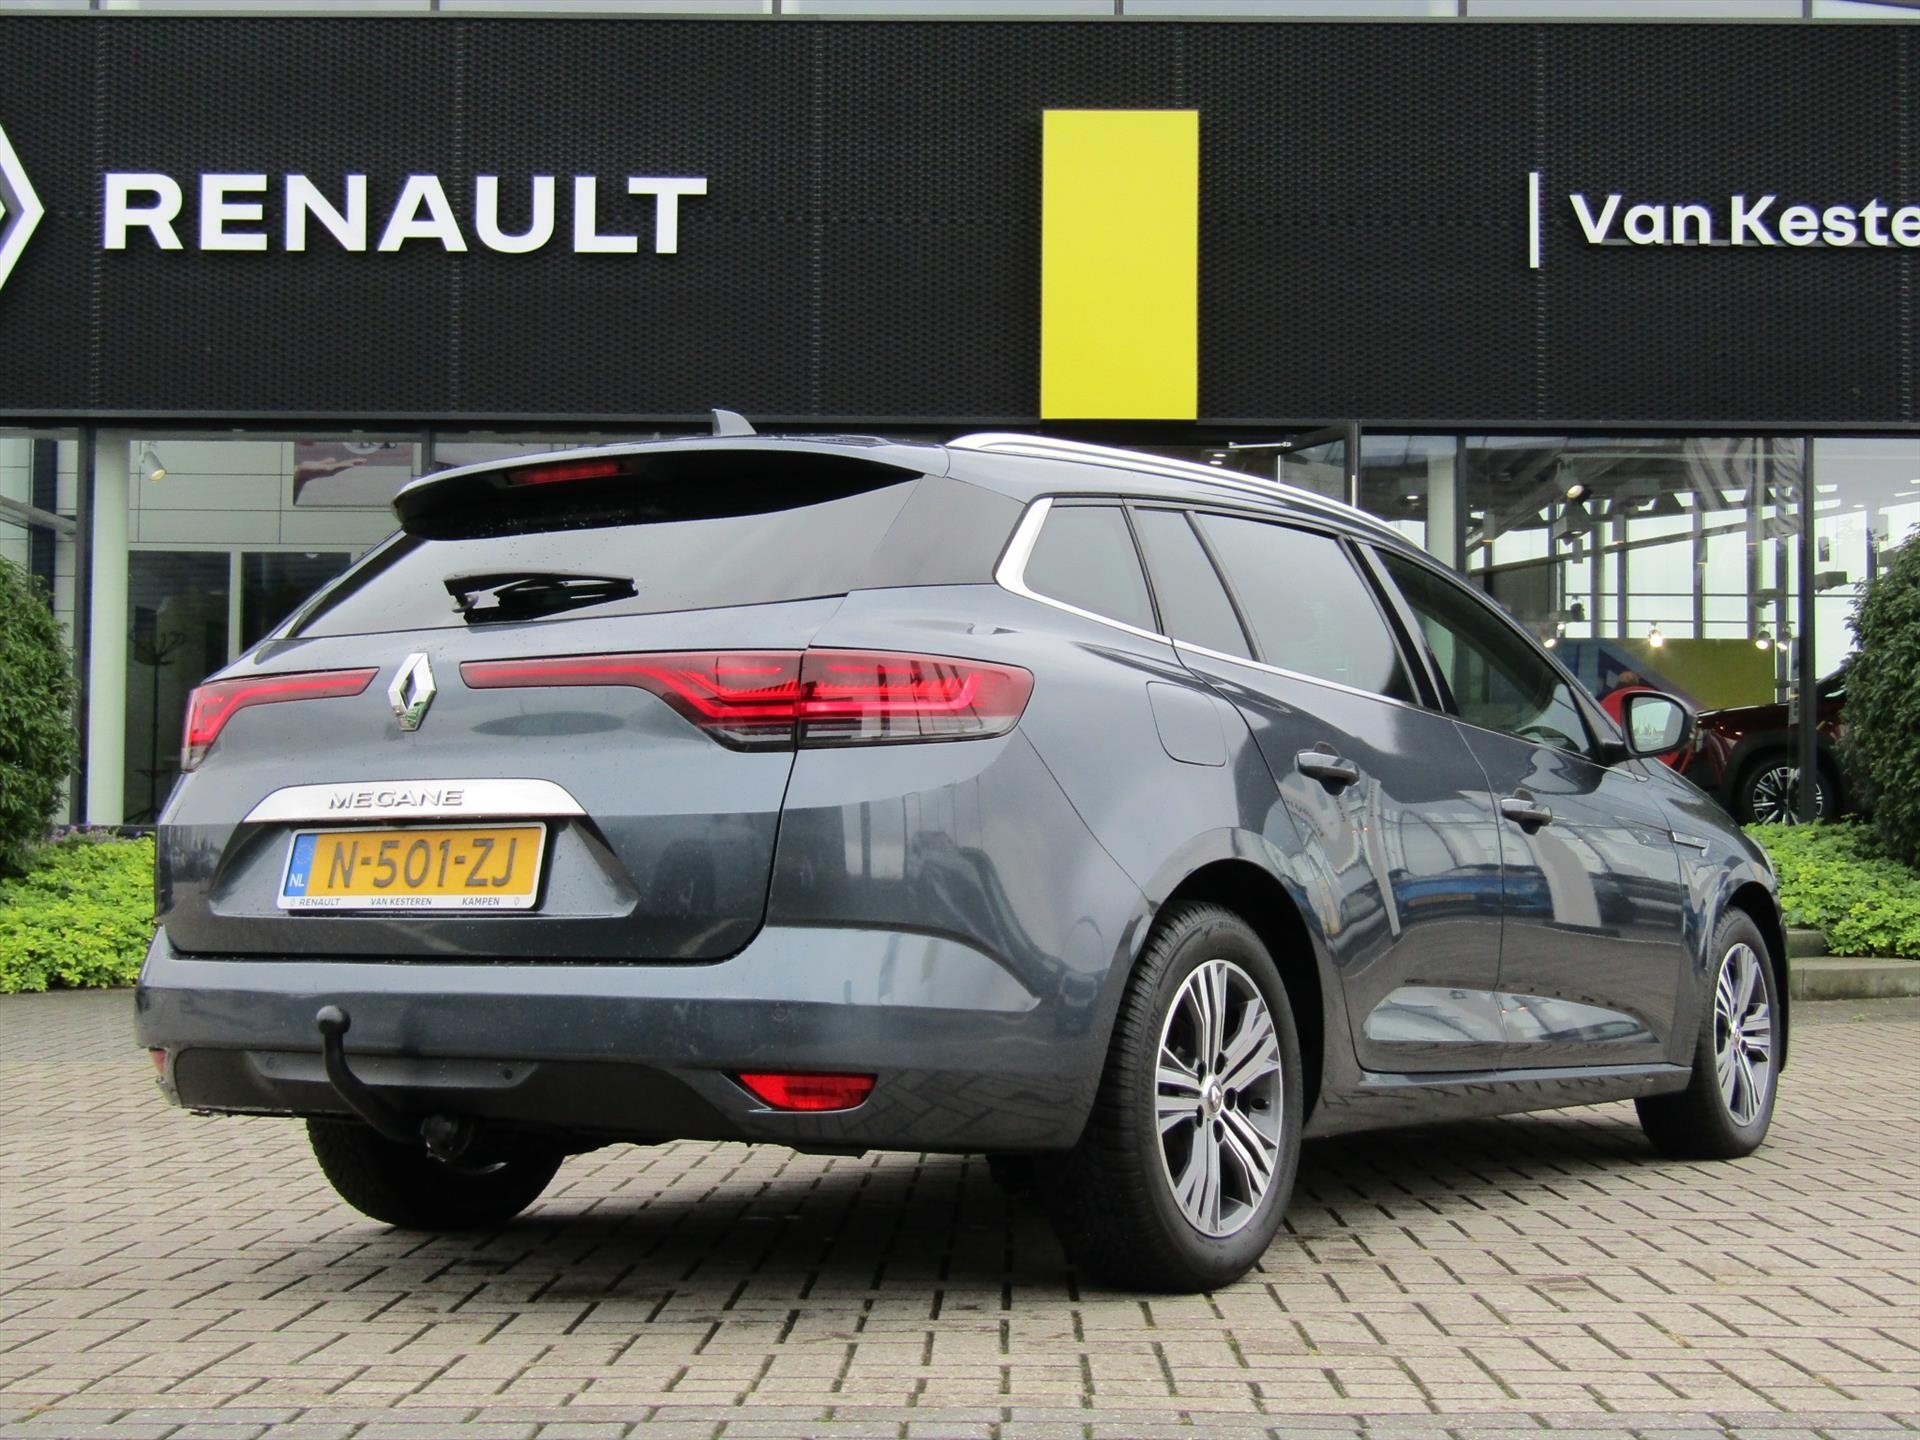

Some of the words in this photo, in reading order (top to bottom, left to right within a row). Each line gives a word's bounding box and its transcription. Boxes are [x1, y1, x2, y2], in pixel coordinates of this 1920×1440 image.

[104, 173, 707, 254] RENAULT
[1570, 194, 1711, 245] Van
[328, 789, 465, 809] MEGANE
[289, 873, 305, 887] NL
[327, 837, 518, 889] N-501-ZJ
[298, 897, 341, 907] RENAULT
[370, 897, 389, 906] VAN
[390, 897, 432, 906] KESTEREN
[462, 896, 501, 906] KAMPEN
